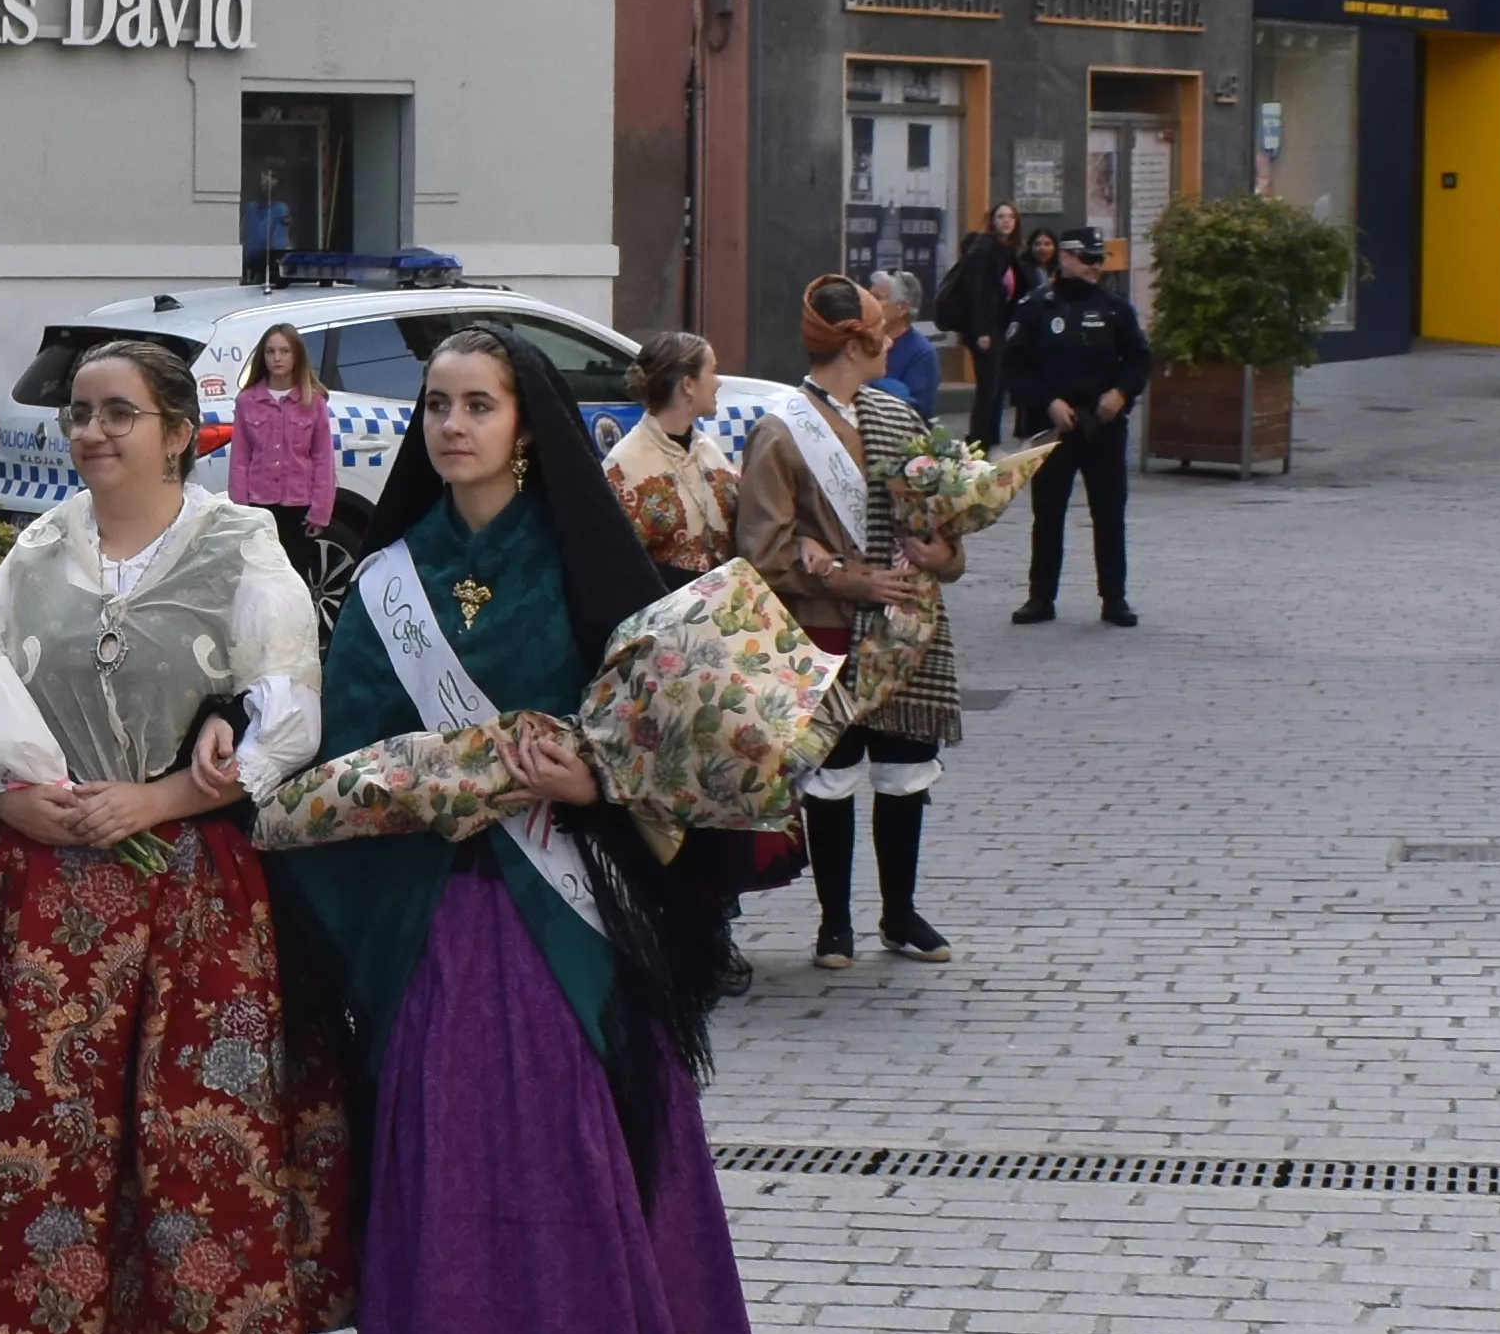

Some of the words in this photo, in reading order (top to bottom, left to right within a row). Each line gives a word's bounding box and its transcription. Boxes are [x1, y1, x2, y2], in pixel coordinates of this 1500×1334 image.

[209, 346, 242, 363] V-0
[207, 384, 222, 395] 112
[48, 436, 70, 453] HUE
[20, 454, 64, 466] KADJAR
